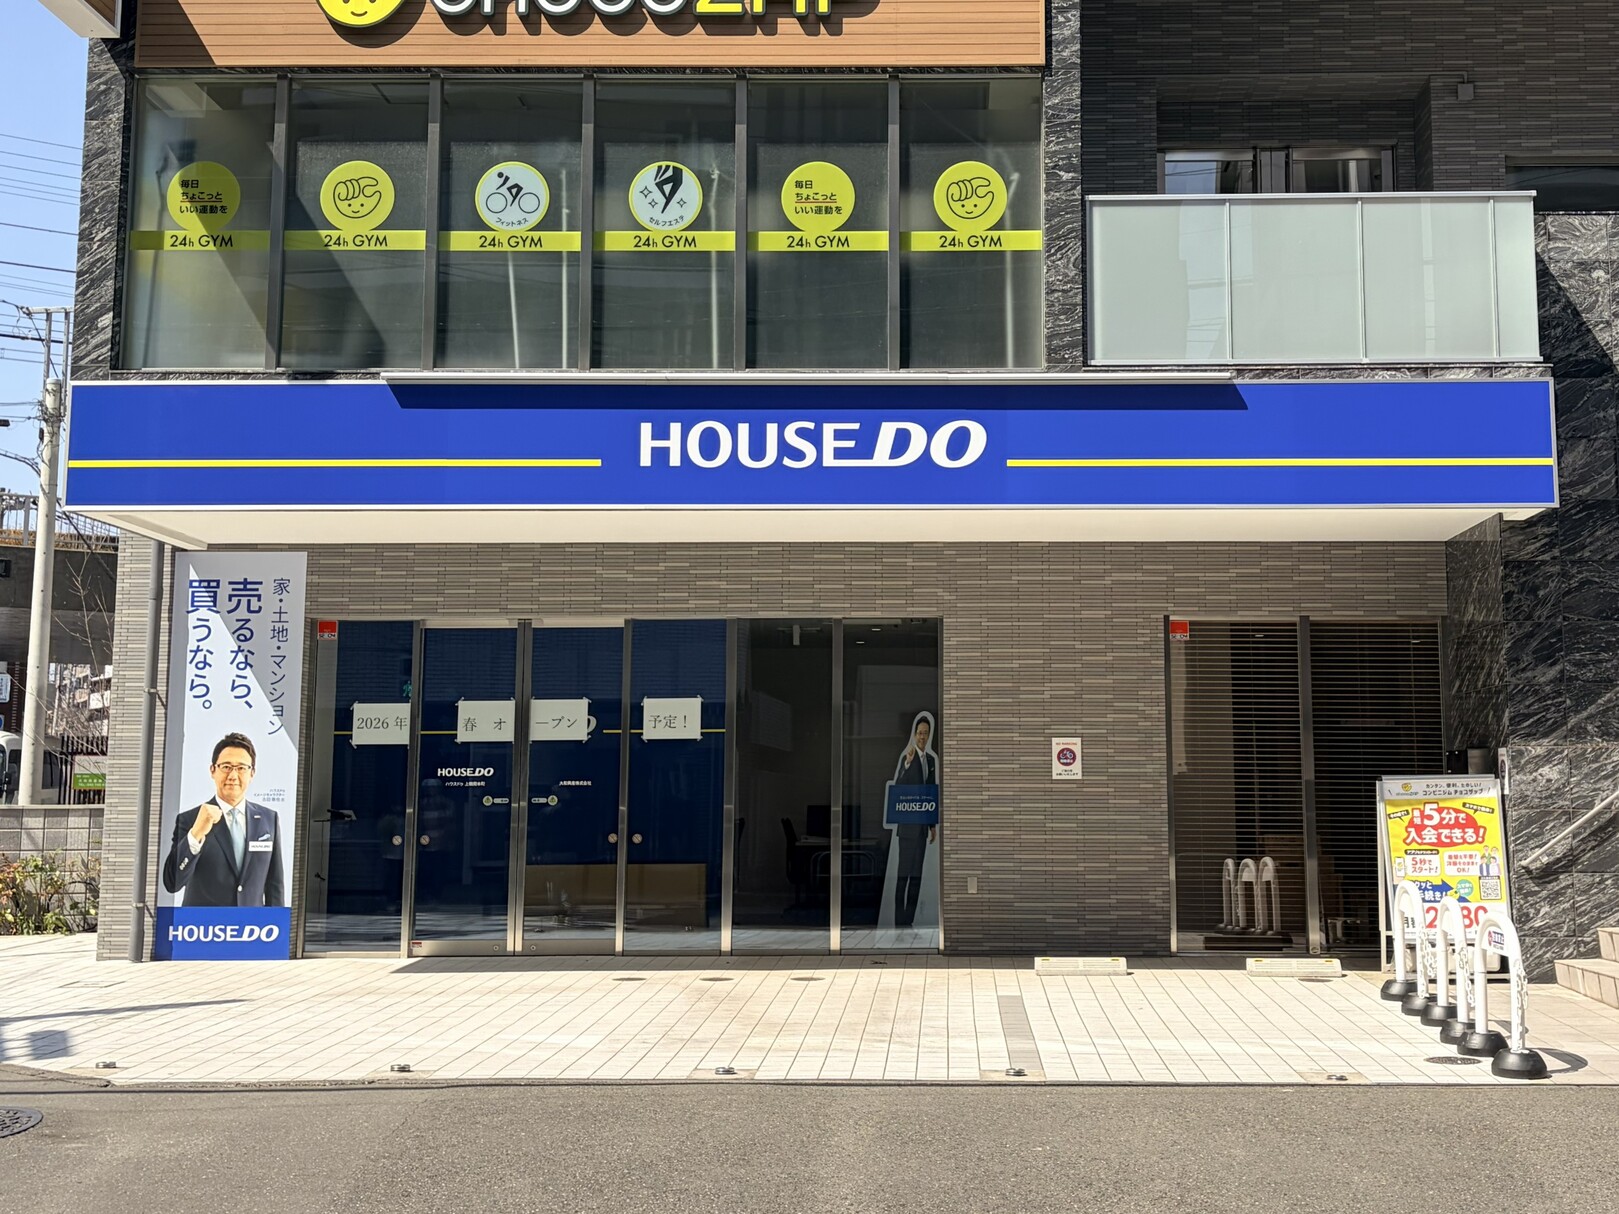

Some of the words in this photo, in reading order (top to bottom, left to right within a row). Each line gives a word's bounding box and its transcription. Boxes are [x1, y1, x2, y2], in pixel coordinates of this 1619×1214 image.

[180, 180, 199, 188] 毎日
[794, 180, 813, 189] 毎日
[180, 192, 222, 200] ちょこっと
[794, 192, 837, 200] ちょこっと
[180, 205, 228, 214] いい運動を
[794, 206, 842, 215] いい運動を
[496, 217, 529, 227] フィットネス
[649, 216, 685, 226] セルフエステ
[170, 235, 194, 247] 24h
[198, 235, 233, 247] GYM
[324, 235, 348, 247] 24h
[353, 235, 388, 247] GYM
[479, 236, 503, 248] 24h
[508, 236, 543, 248] GYM
[634, 236, 657, 248] 24h
[662, 236, 697, 248] GYM
[787, 236, 810, 248] 24h
[815, 236, 850, 248] GYM
[939, 236, 963, 248] 24h
[967, 236, 1002, 248] GYM
[186, 579, 221, 710] 買うなら。
[226, 578, 263, 709] 売るなら、
[268, 578, 291, 735] 家・土地・マンション
[462, 717, 477, 731] 春
[648, 715, 687, 729] 予定！
[1423, 802, 1466, 826] 5分で
[1405, 826, 1484, 843] 入会できる!
[1411, 857, 1432, 866] 5秒で
